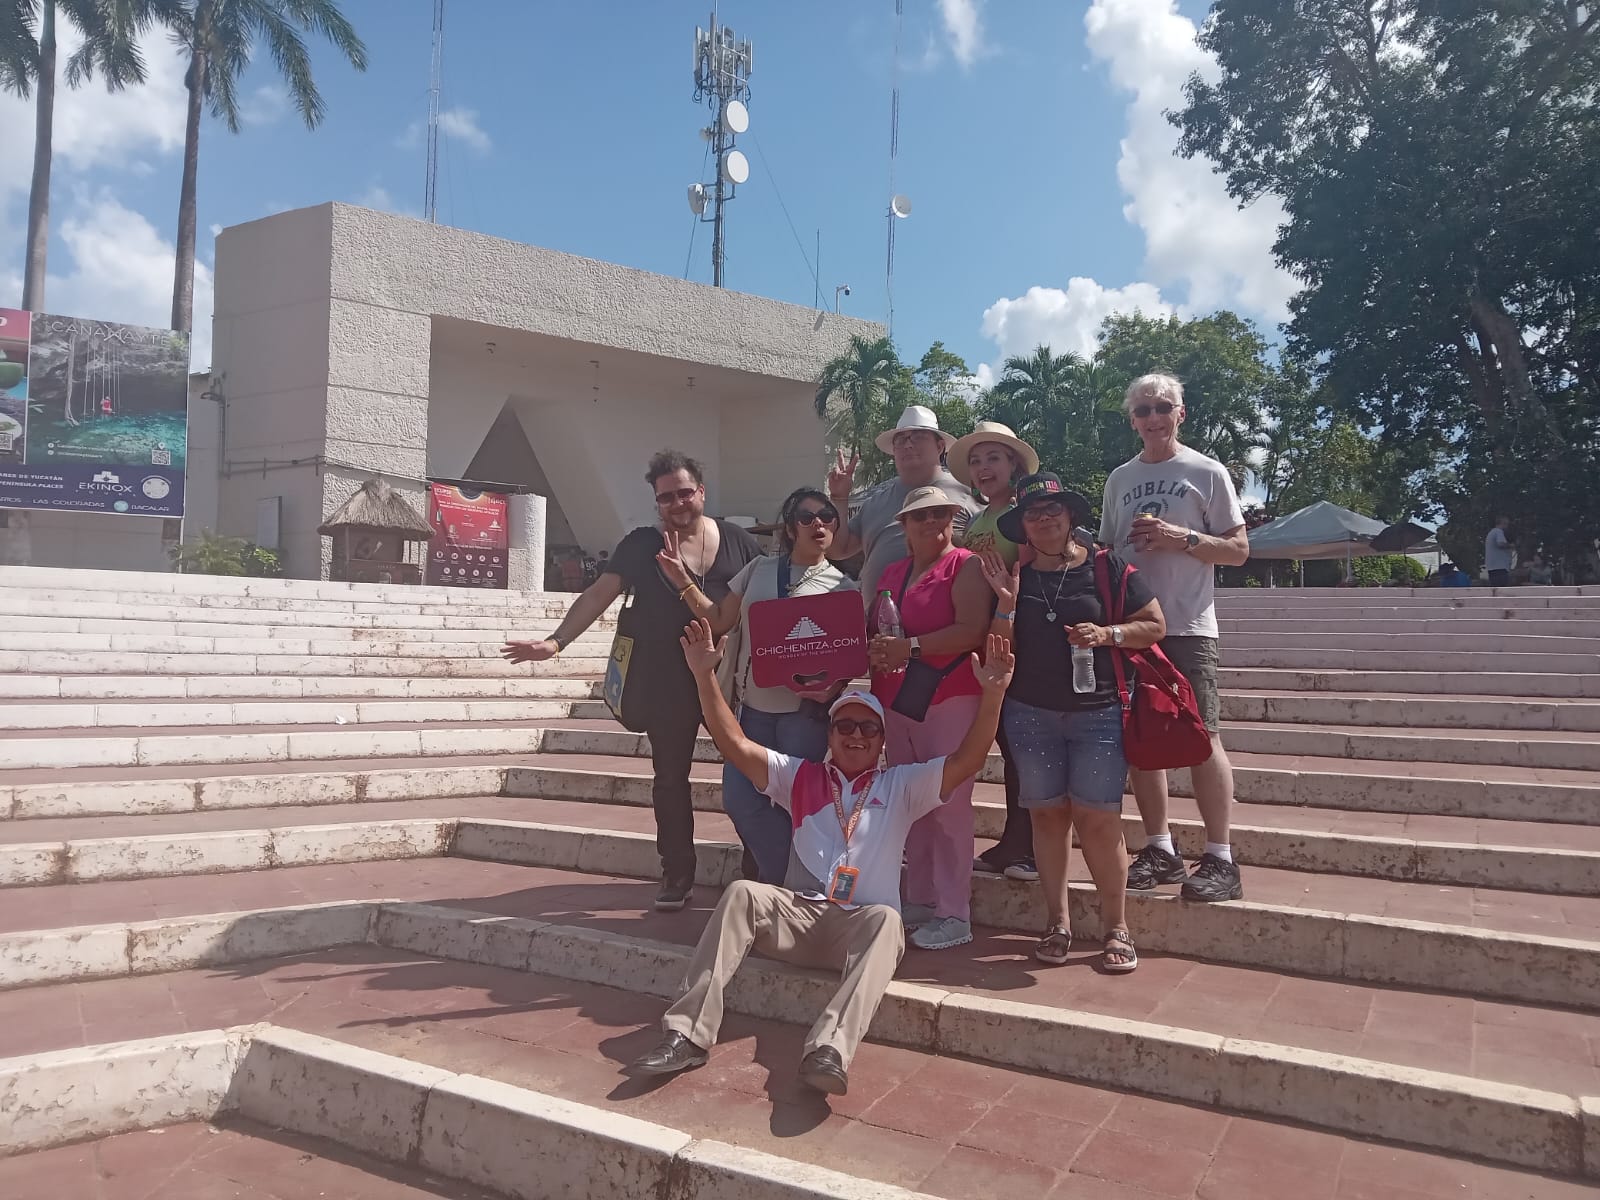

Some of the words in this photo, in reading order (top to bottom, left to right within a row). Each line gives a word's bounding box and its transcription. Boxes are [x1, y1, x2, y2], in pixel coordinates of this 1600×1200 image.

[78, 482, 133, 493] EKINOX
[1122, 480, 1188, 506] DUBLIN
[756, 638, 859, 656] CHICHENITZA.COM
